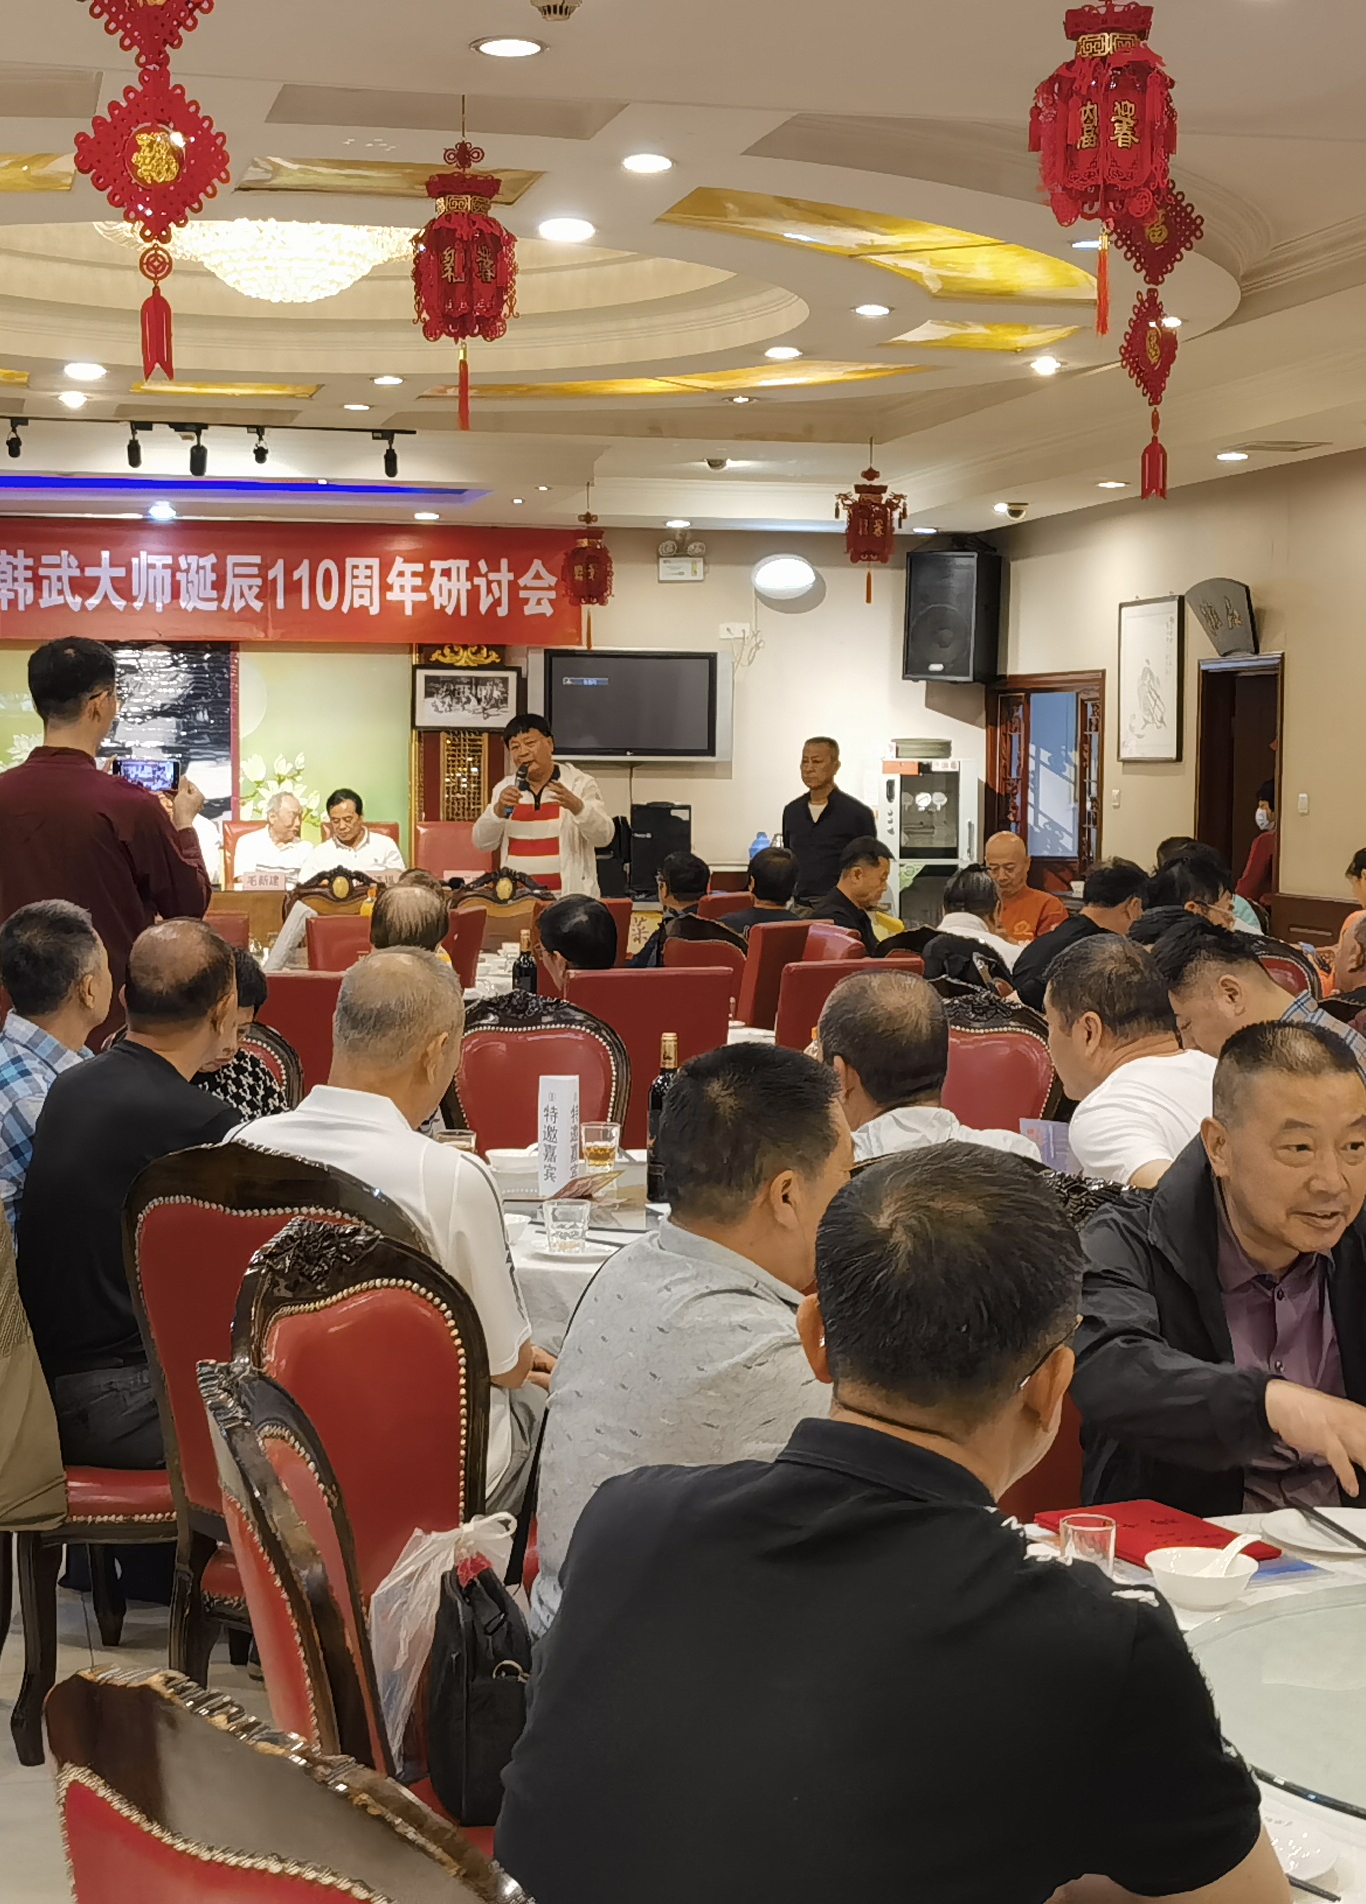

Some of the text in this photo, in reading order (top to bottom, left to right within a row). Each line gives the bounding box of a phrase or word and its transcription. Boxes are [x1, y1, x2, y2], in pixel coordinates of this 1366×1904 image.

[1110, 100, 1139, 149] 迎春
[542, 1104, 558, 1183] 特邀嘉宾
